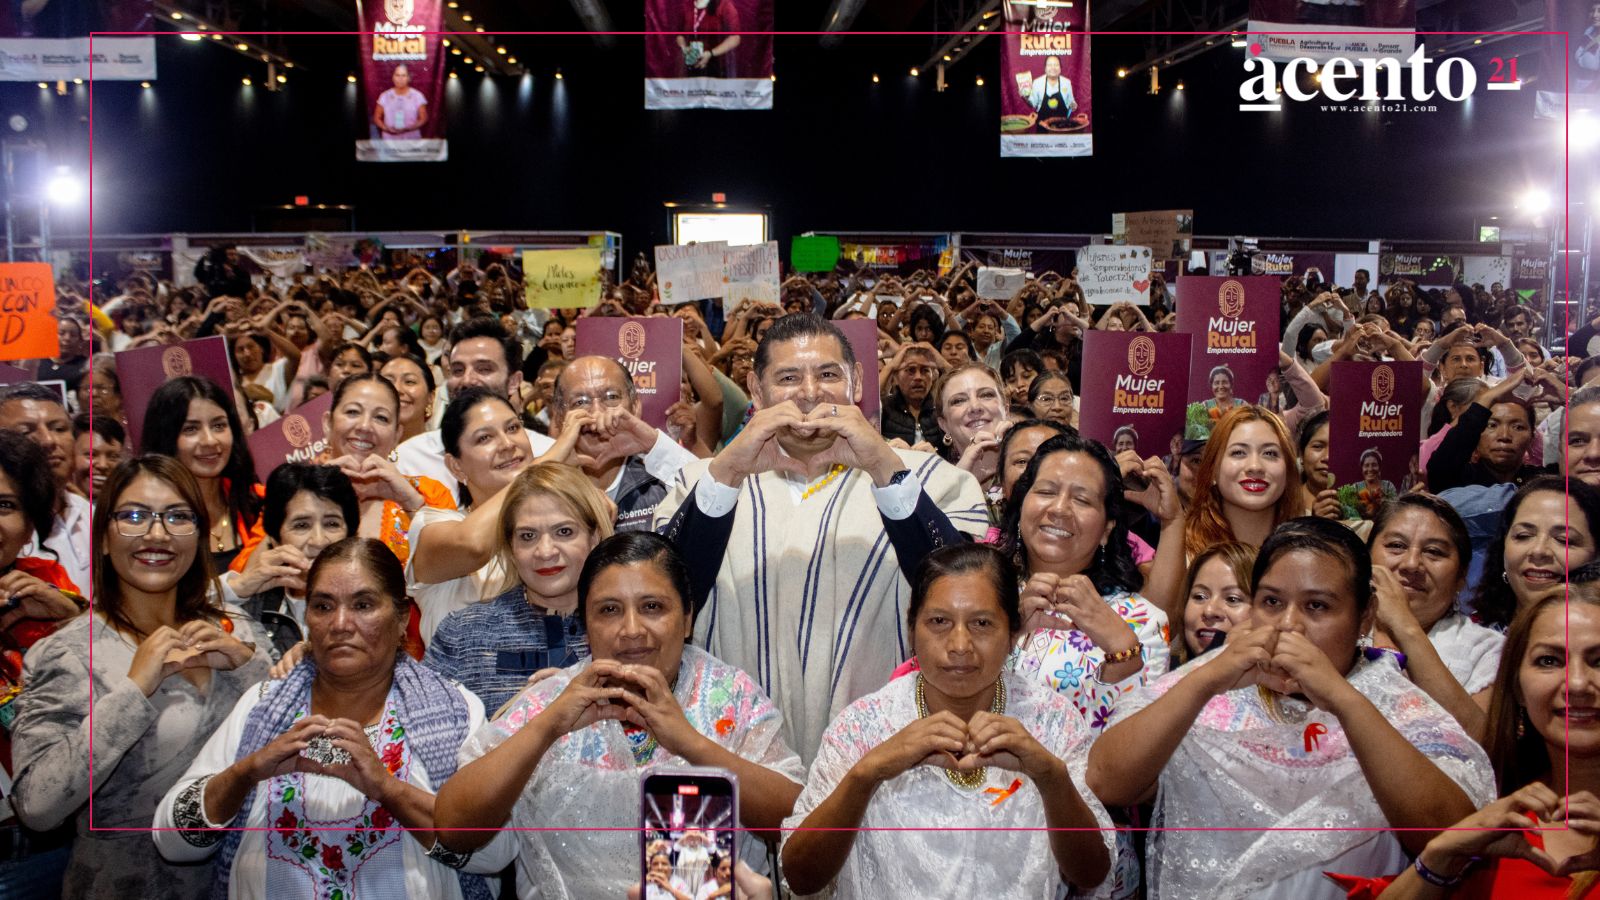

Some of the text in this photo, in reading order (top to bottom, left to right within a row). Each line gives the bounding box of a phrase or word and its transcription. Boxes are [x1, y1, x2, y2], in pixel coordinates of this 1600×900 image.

[374, 21, 426, 42] Mujer
[373, 34, 426, 54] Rural
[1021, 32, 1072, 50] Rural
[1268, 37, 1295, 45] PUEBLA
[1020, 48, 1072, 56] Emprendedora
[1004, 249, 1032, 259] Mujer
[1266, 254, 1294, 264] Mujer
[1395, 255, 1422, 264] Mujer
[1266, 262, 1293, 271] Rural
[1521, 258, 1548, 268] Mujer
[3, 292, 39, 312] CON
[1208, 316, 1256, 336] Mujer
[1207, 331, 1256, 347] Rural
[1206, 347, 1257, 355] Emprendedora
[632, 371, 656, 387] ral
[1115, 374, 1165, 395] Mujer
[1114, 389, 1165, 407] Rural
[1112, 406, 1164, 414] Emprendedora
[1360, 400, 1403, 419] Mujer
[1360, 414, 1402, 431] Rural
[1358, 430, 1403, 438] Emprendedora
